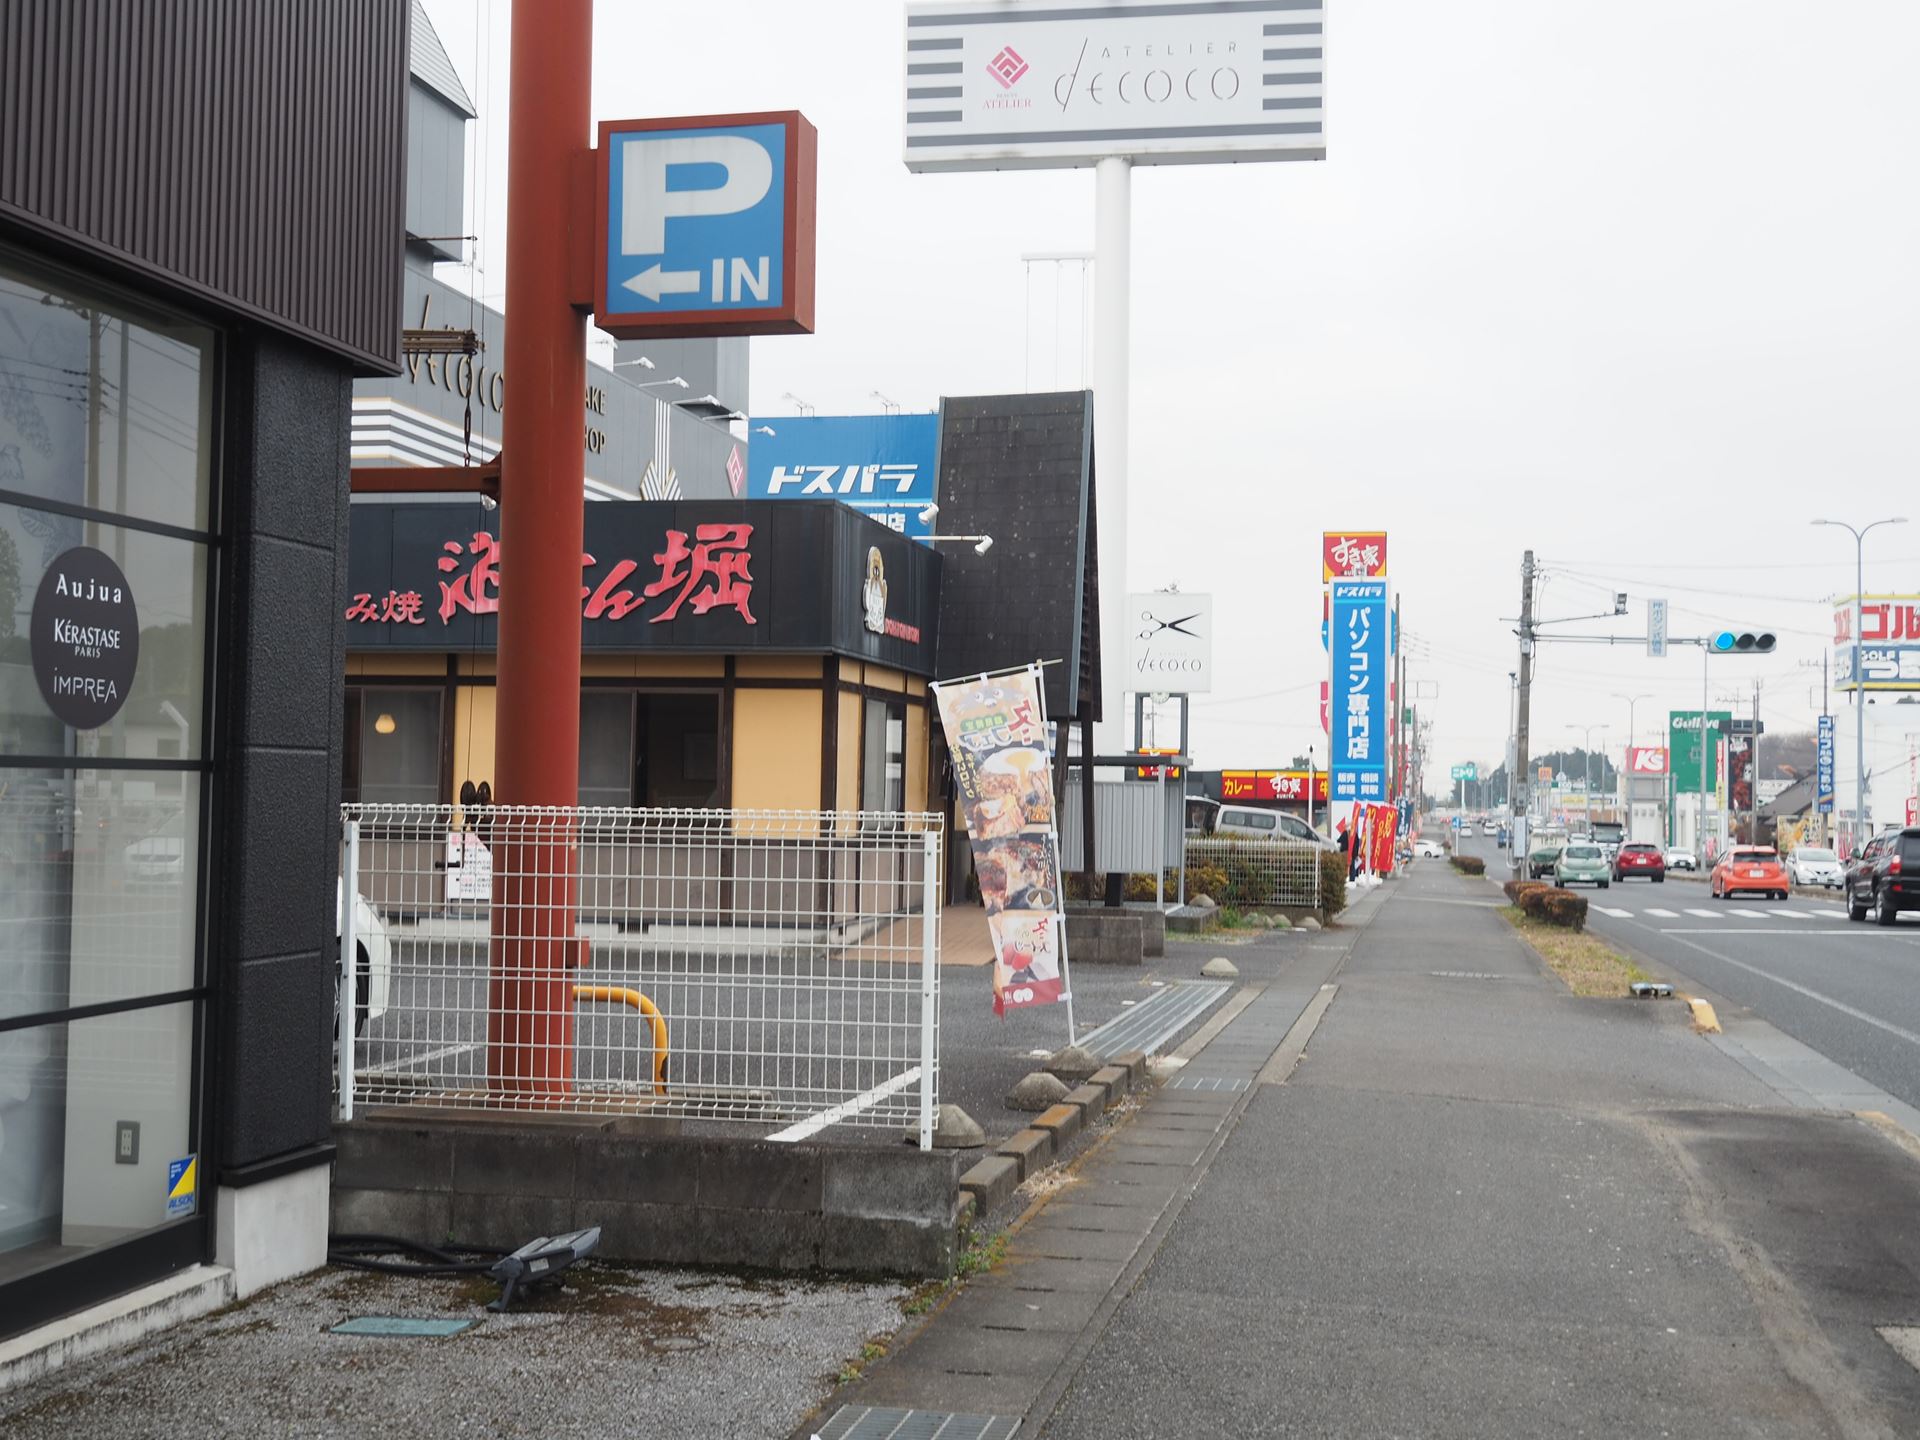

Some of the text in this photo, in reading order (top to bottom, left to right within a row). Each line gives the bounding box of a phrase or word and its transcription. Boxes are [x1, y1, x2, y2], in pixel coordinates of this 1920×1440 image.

[1101, 42, 1237, 58] ATELIER
[621, 135, 773, 256] P
[711, 256, 770, 303] IN
[767, 464, 919, 495] ドスパラ
[1331, 536, 1379, 568] すき家
[55, 573, 122, 604] Aujua
[74, 645, 101, 659] PARIS
[1347, 606, 1371, 760] パソコン専門店
[1224, 778, 1254, 796] カレー
